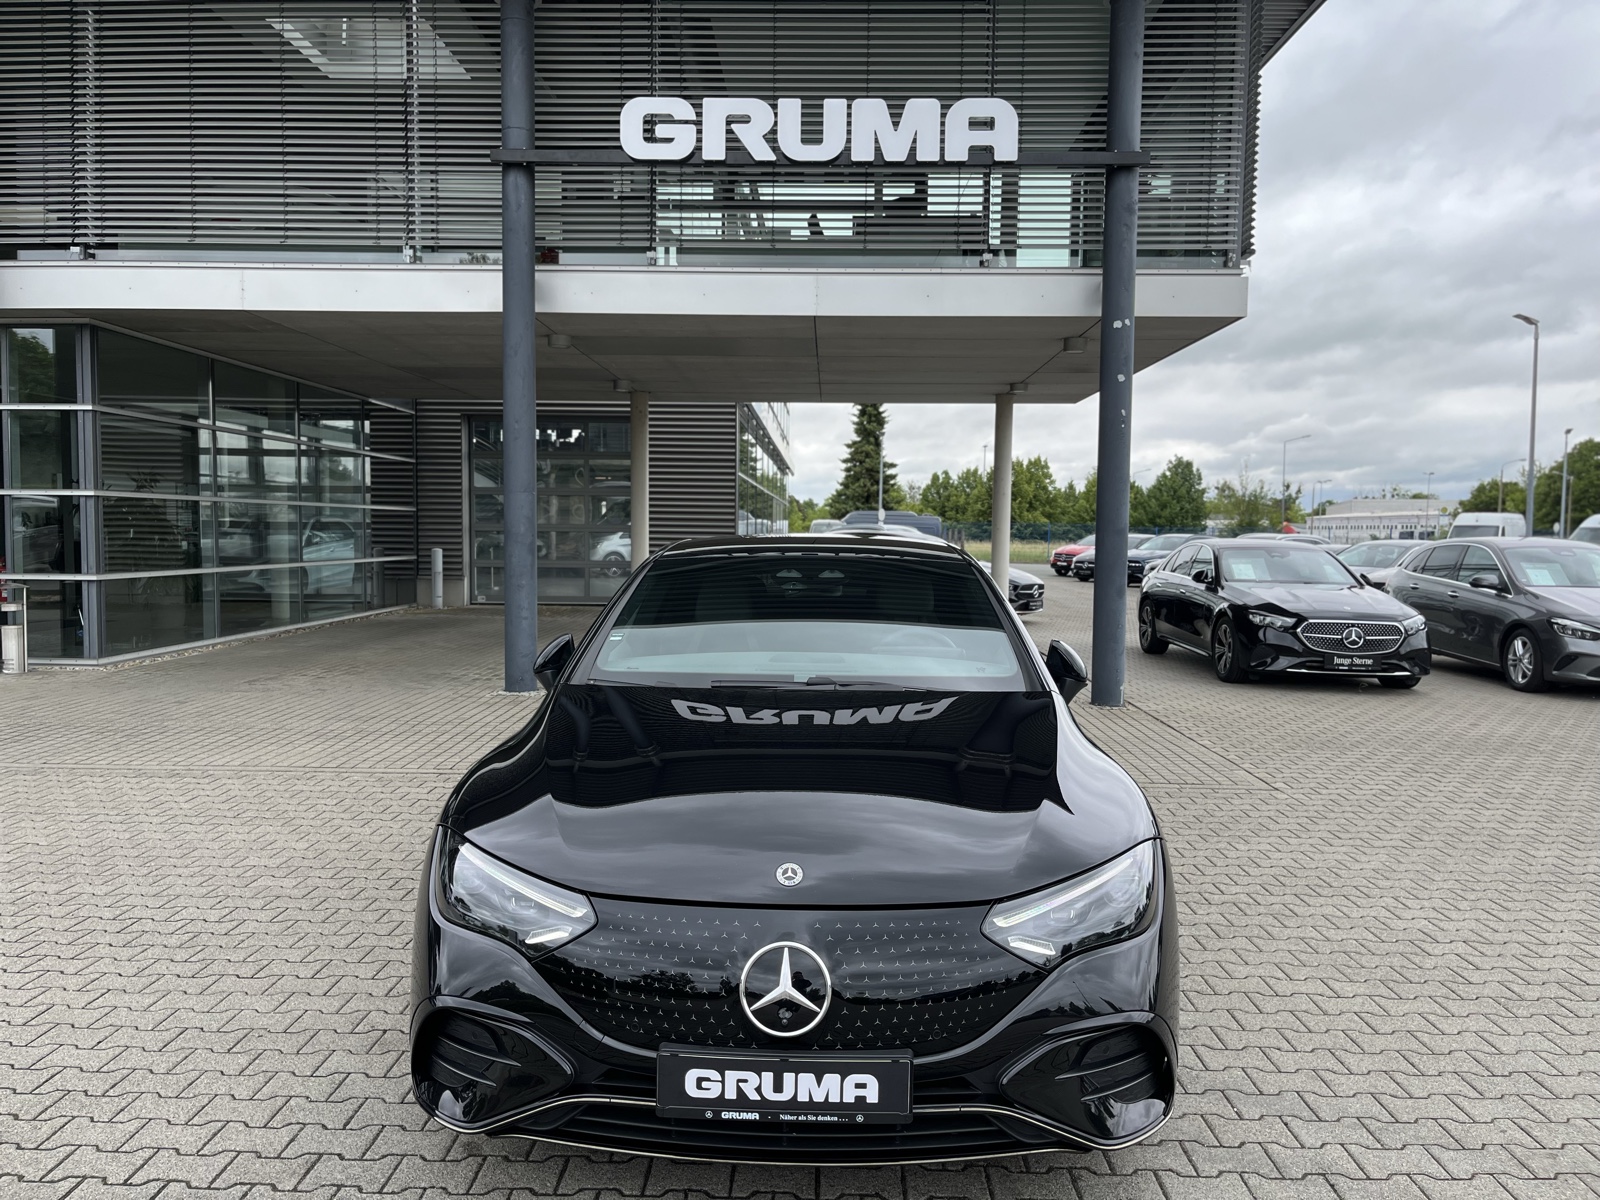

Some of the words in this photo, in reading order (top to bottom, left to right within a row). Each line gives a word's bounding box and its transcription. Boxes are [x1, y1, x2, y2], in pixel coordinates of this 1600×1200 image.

[619, 96, 1019, 162] GRUMA
[1333, 656, 1352, 665] Junge
[1352, 656, 1374, 665] Sterne
[684, 1068, 879, 1104] GRUMA
[721, 1111, 760, 1120] GRUMA
[780, 1113, 798, 1121] Näher
[817, 1114, 838, 1122] denken
